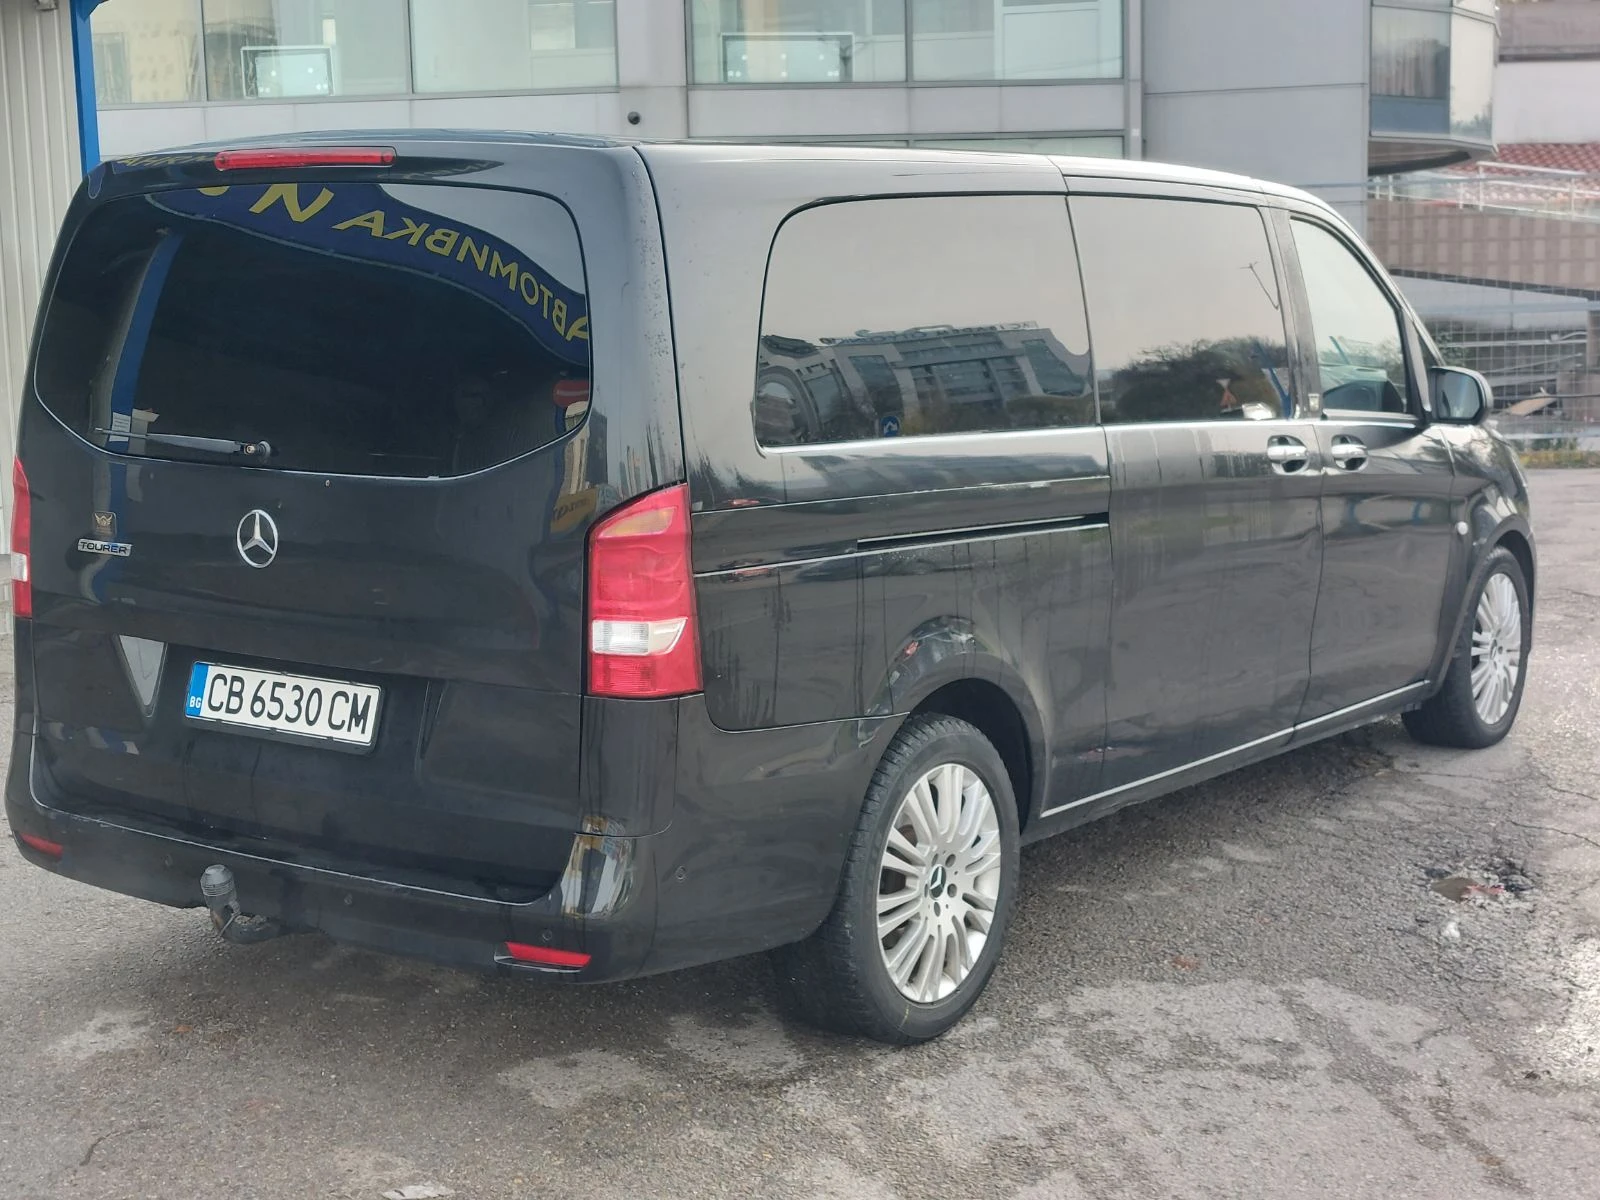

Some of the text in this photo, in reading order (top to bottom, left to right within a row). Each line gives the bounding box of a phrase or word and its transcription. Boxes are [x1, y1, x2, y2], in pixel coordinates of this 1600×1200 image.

[79, 540, 129, 555] TOURER
[189, 695, 202, 709] BG
[207, 673, 372, 735] CB 6530 CM
